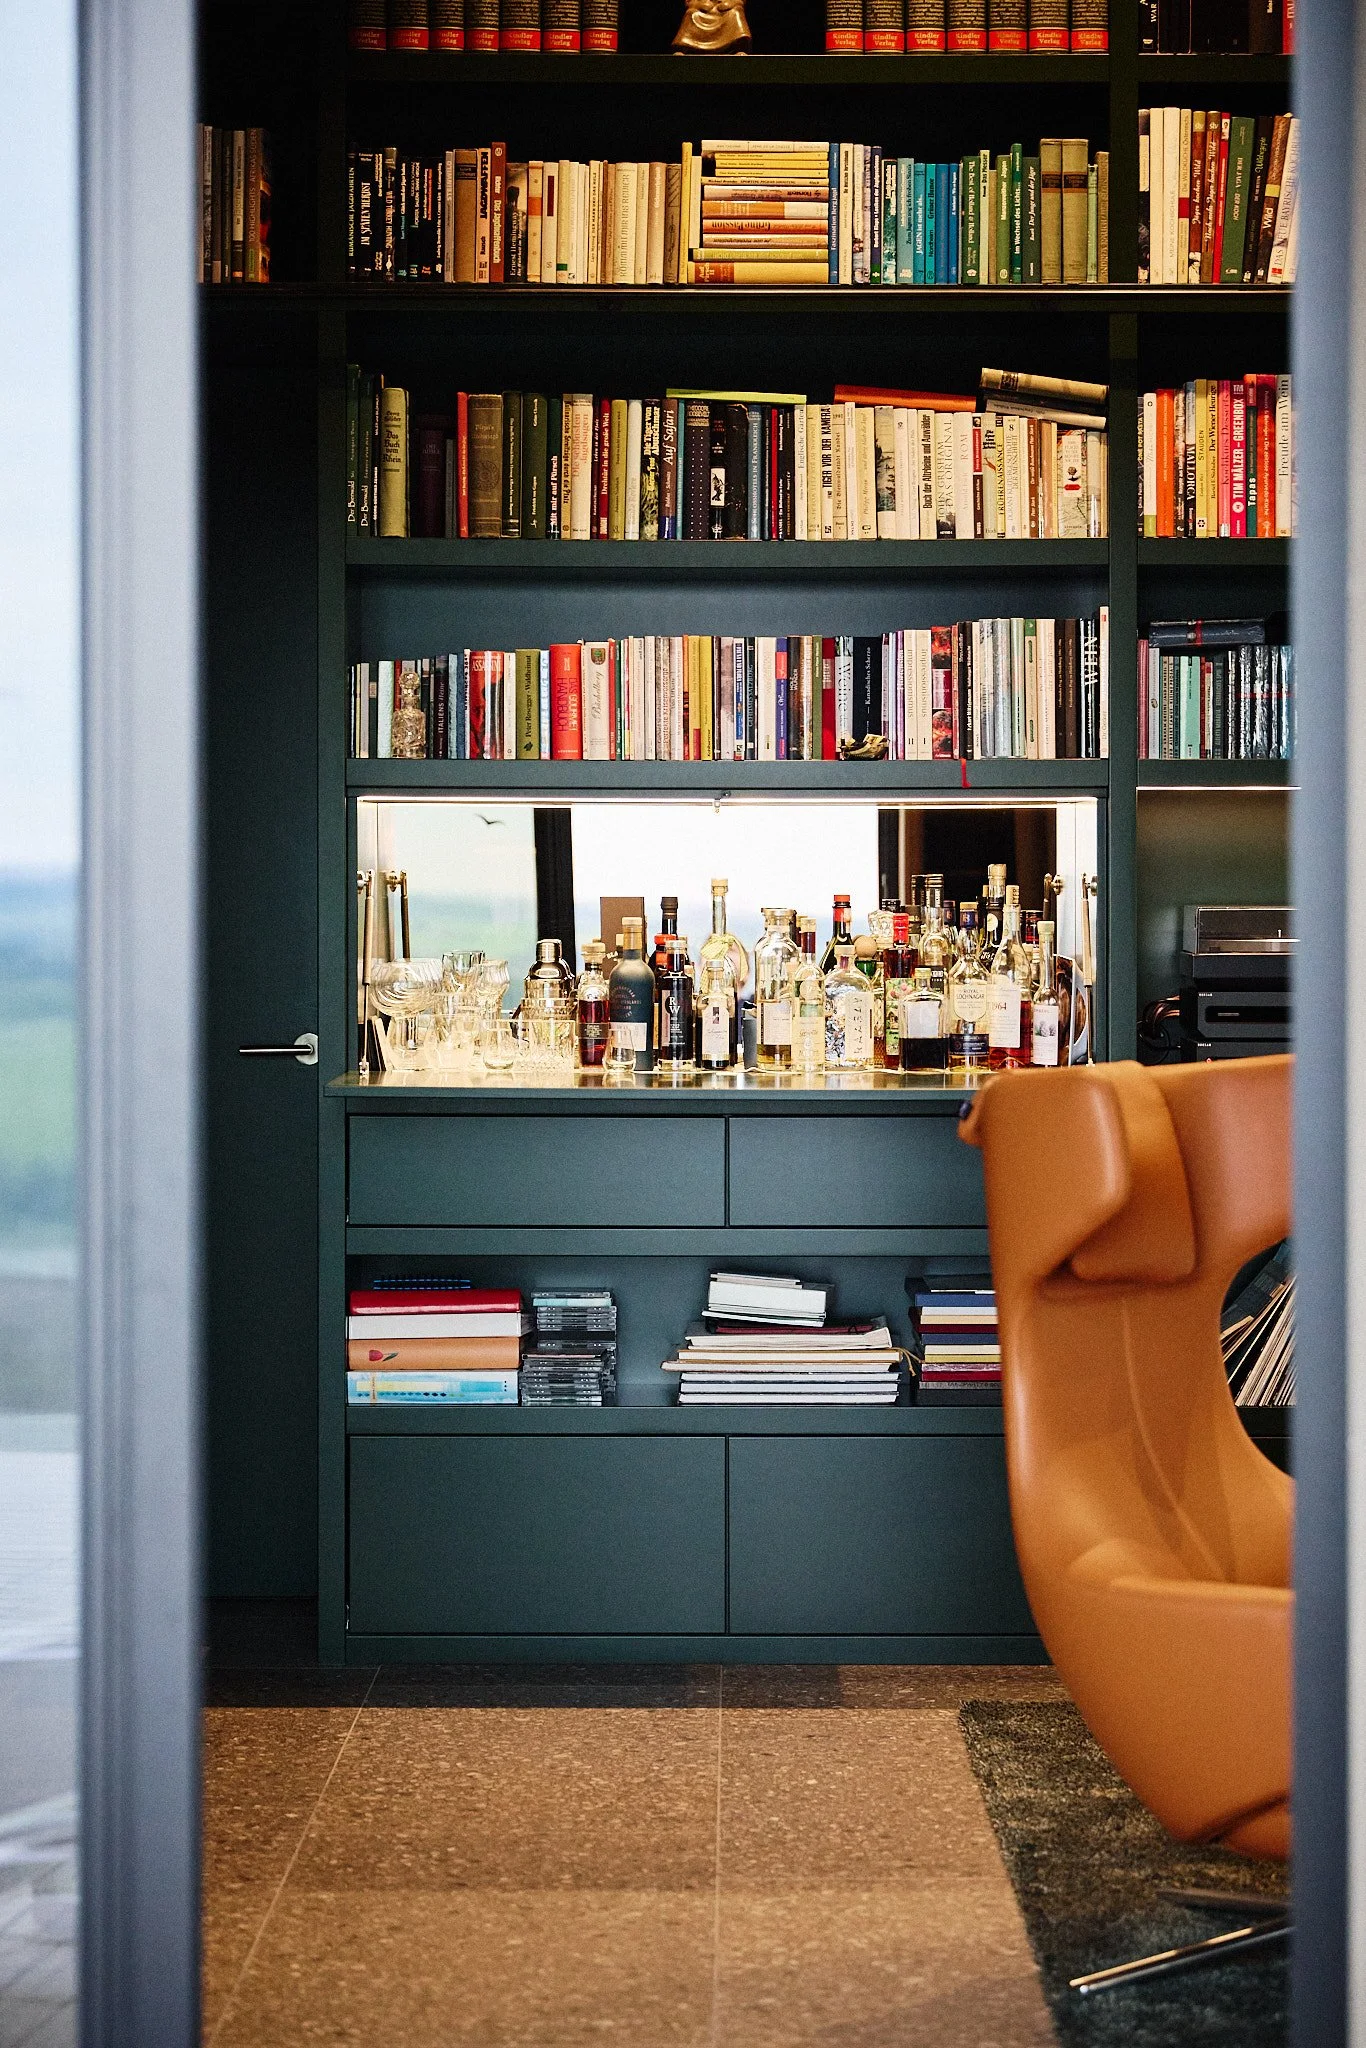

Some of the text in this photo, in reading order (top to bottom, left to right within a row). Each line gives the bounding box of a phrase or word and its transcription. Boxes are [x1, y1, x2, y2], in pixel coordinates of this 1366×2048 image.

[480, 152, 488, 219] JAGDWAFFEN
[1208, 161, 1216, 183] kochen
[1192, 160, 1201, 224] Jäger kochen Wild
[510, 212, 518, 252] Hemingway
[712, 221, 771, 231] Grüne Passion
[1262, 207, 1274, 228] Wild
[1274, 250, 1284, 265] DAS
[1280, 177, 1292, 220] BAYRISCHE
[385, 226, 393, 249] HUNTING
[493, 212, 501, 263] Jagdwaffenbuch
[1015, 245, 1020, 254] Im
[386, 430, 399, 439] Das
[644, 422, 652, 442] Tiger
[1233, 399, 1244, 441] GREENBOX
[1279, 379, 1288, 476] Freude am Wein
[384, 440, 400, 448] Buch
[581, 414, 589, 464] Jagdsagen
[643, 443, 651, 455] Die
[663, 410, 675, 465] Auf Safari
[820, 408, 832, 488] TIGER VOR DER KAMERA
[382, 455, 401, 463] Rhein
[550, 456, 558, 481] Pürsch
[602, 459, 608, 467] in
[921, 414, 932, 508] Buch der Altrheine und Auwälder
[944, 420, 953, 507] DAS ORIGINAL
[1186, 446, 1195, 500] MALLORCA
[1231, 448, 1244, 481] MÄLZER
[550, 482, 558, 495] auf
[550, 496, 558, 511] mir
[563, 489, 571, 504] Pfalz
[1233, 482, 1243, 499] TIM
[1248, 477, 1256, 506] Tapas
[1084, 636, 1098, 685] WEIN
[838, 663, 851, 712] Weine
[905, 649, 914, 718] impressionismus
[920, 649, 929, 718] impressionismus
[557, 678, 568, 731] HANDBUCH
[569, 678, 578, 731] DAS GOURMET
[669, 997, 677, 1005] R
[669, 1006, 680, 1014] W
